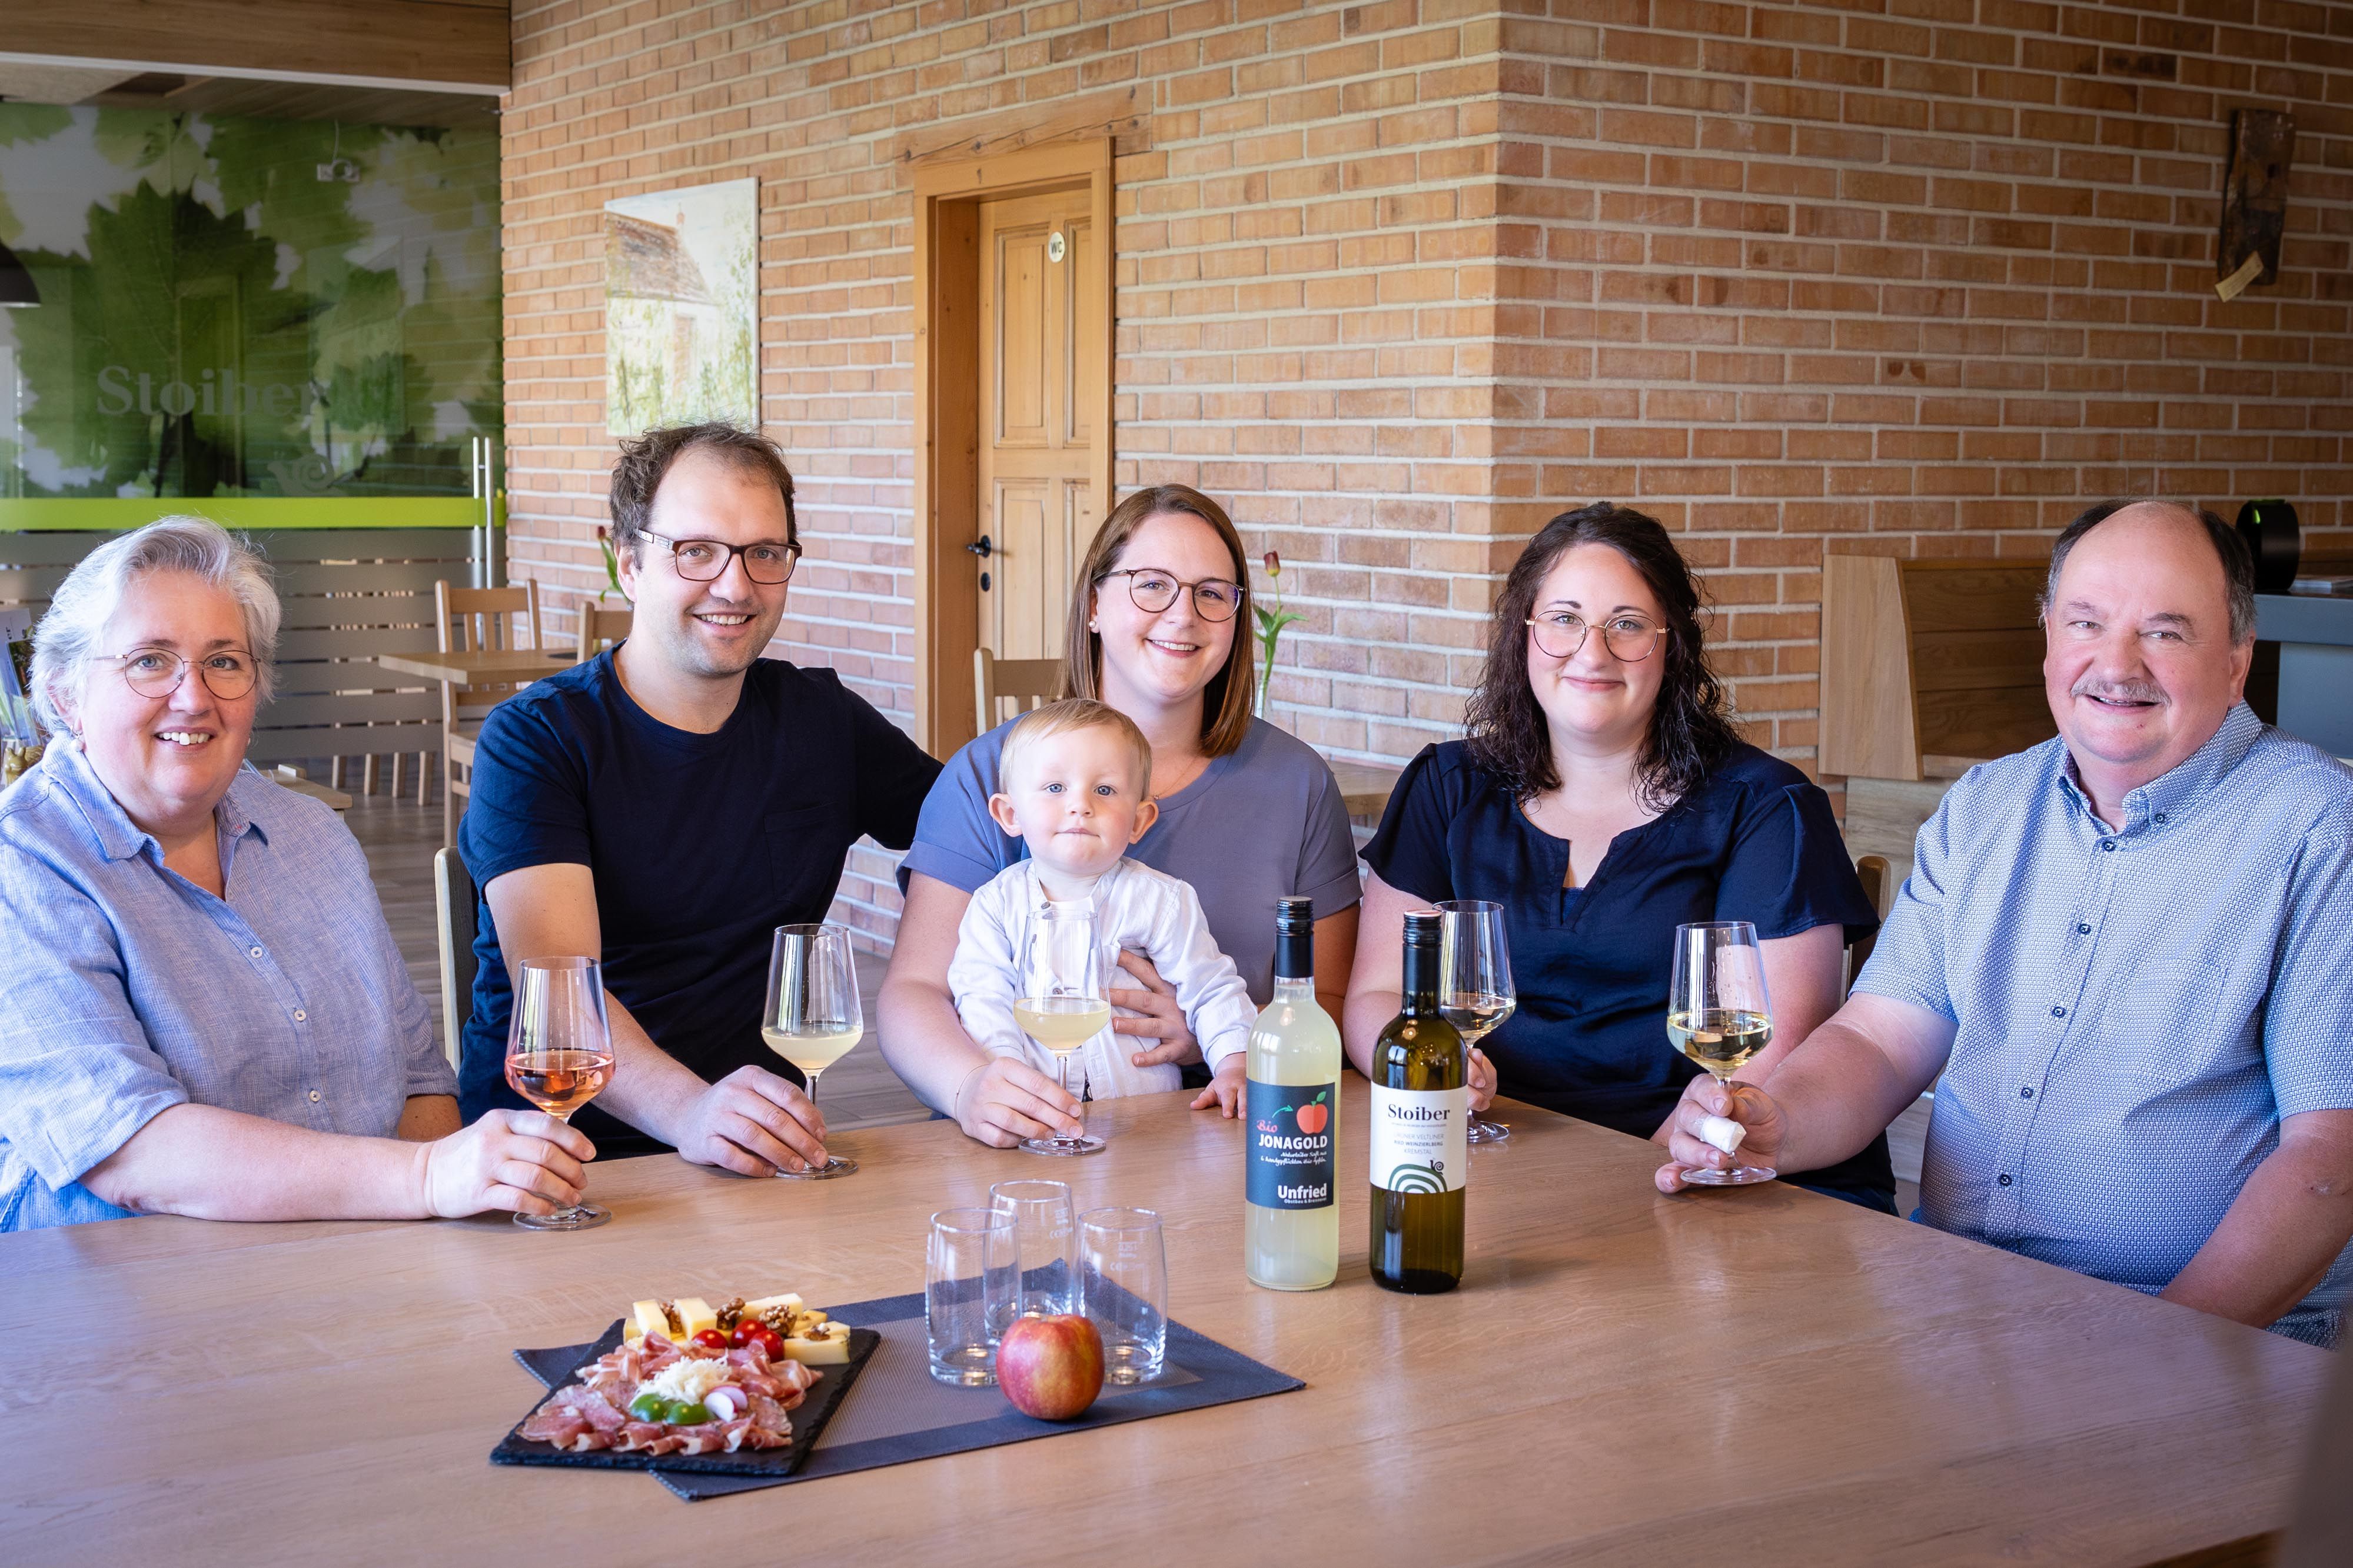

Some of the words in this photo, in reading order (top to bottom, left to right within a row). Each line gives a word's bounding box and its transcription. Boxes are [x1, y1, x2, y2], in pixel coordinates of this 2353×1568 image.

[1051, 241, 1062, 254] WC
[97, 365, 326, 417] Stoiber
[1388, 1104, 1450, 1121] Stoiber
[1257, 1120, 1278, 1133] Bio
[1259, 1134, 1328, 1150] JONAGOLD
[1278, 1183, 1327, 1199] Unfried
